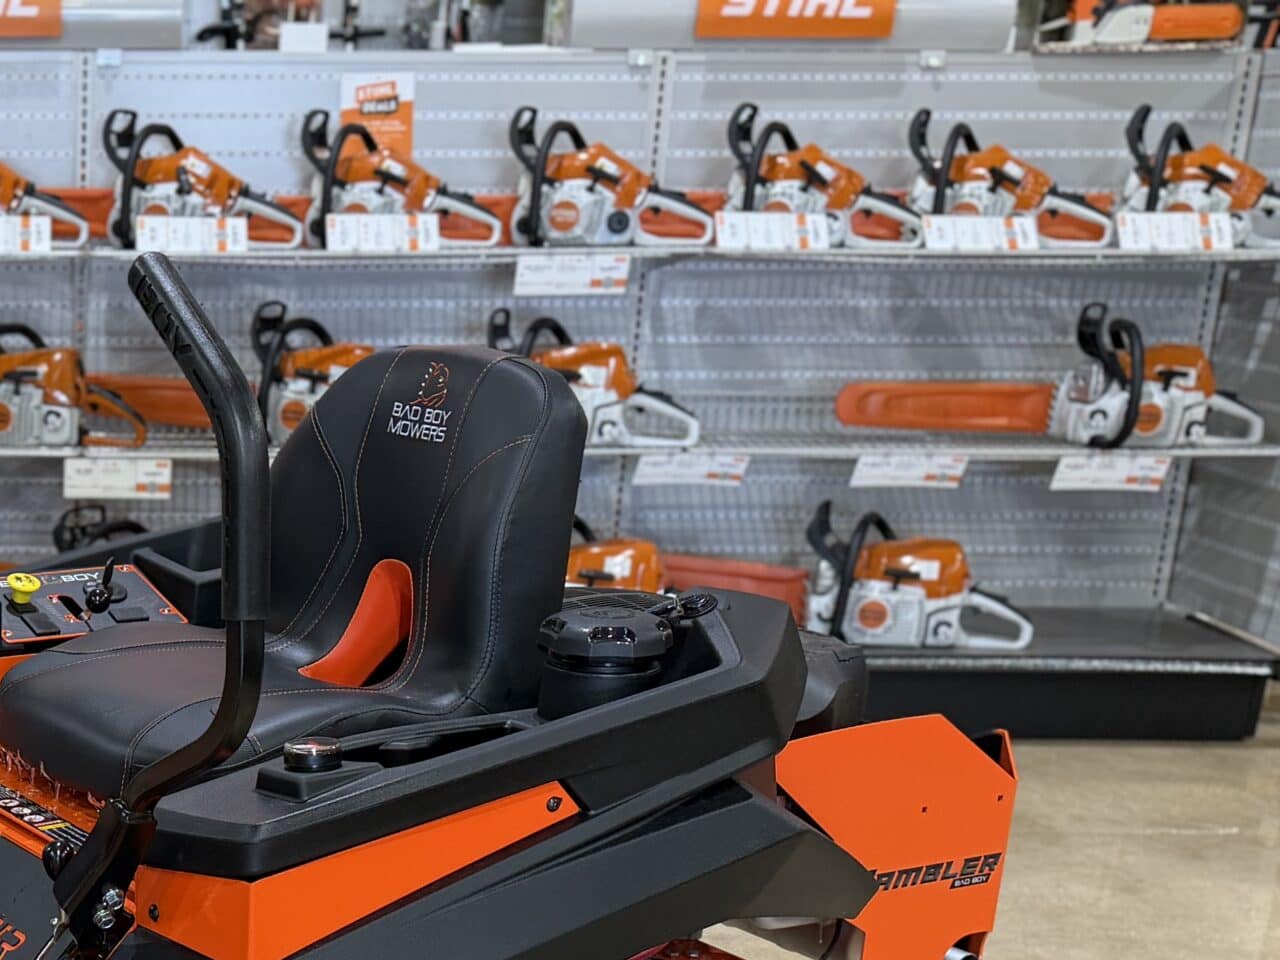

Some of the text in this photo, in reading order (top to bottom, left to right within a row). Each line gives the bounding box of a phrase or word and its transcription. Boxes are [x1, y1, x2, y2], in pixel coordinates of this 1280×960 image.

[392, 402, 451, 425] BAD BOY
[387, 418, 447, 442] MOWERS
[60, 572, 99, 582] BOY
[870, 852, 1002, 891] AMBLER
[954, 874, 988, 887] BAD BOY
